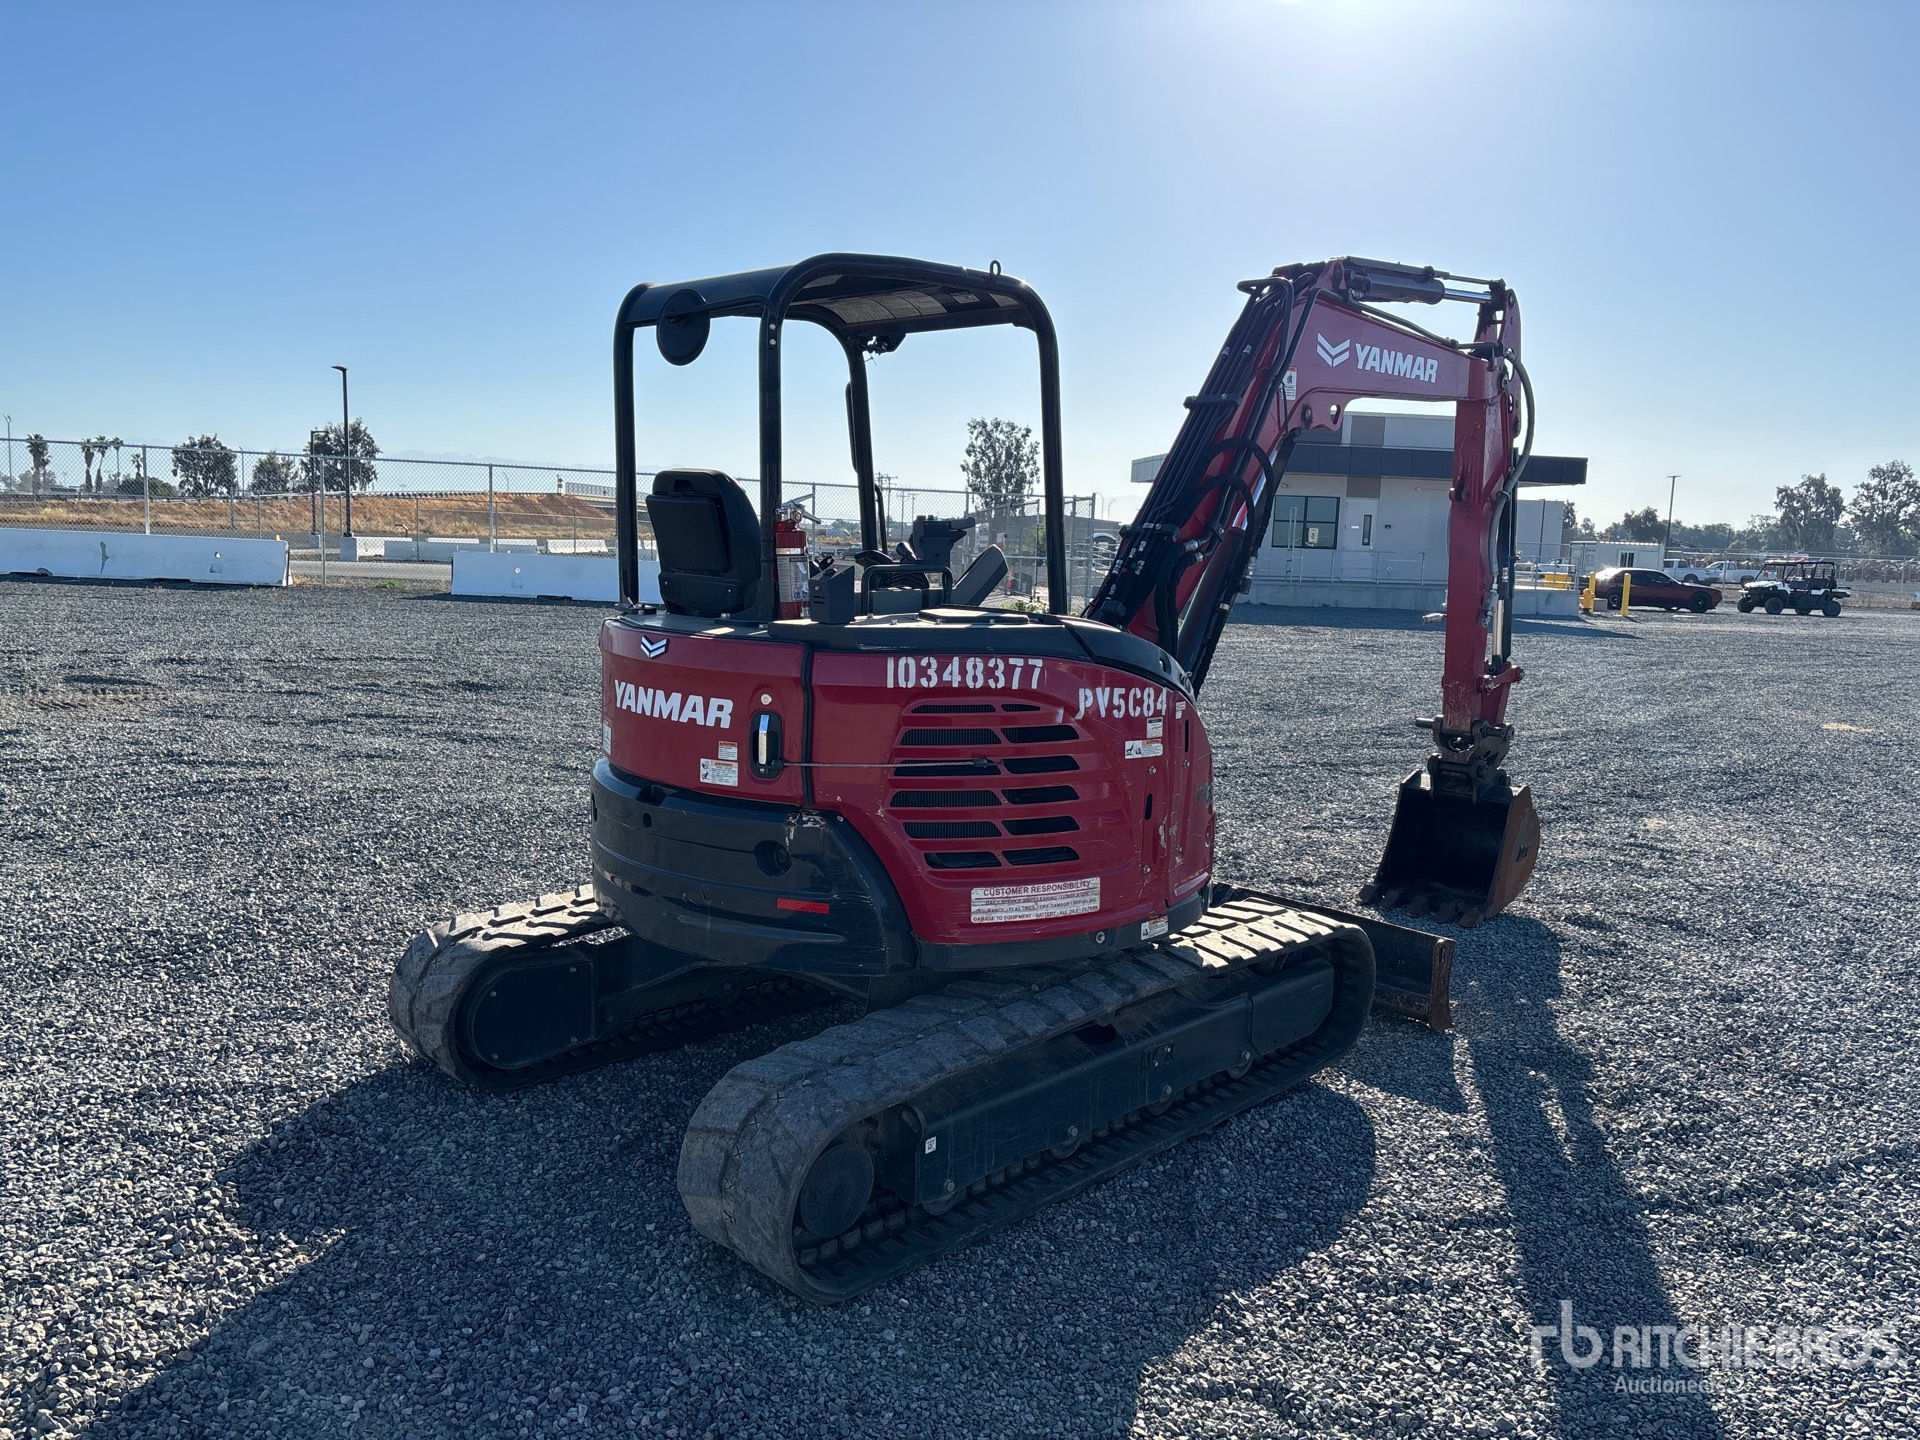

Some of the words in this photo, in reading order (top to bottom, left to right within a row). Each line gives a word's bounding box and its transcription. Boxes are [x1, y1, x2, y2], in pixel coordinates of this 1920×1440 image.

[1355, 343, 1438, 383] YANMAR
[887, 656, 1043, 689] 10348377
[614, 679, 734, 729] YANMAR
[1074, 686, 1167, 720] PV5C84
[983, 887, 1029, 897] CUSTOMER
[1031, 880, 1091, 893] RESPONSIBILITY
[1035, 910, 1056, 918] BATTERY
